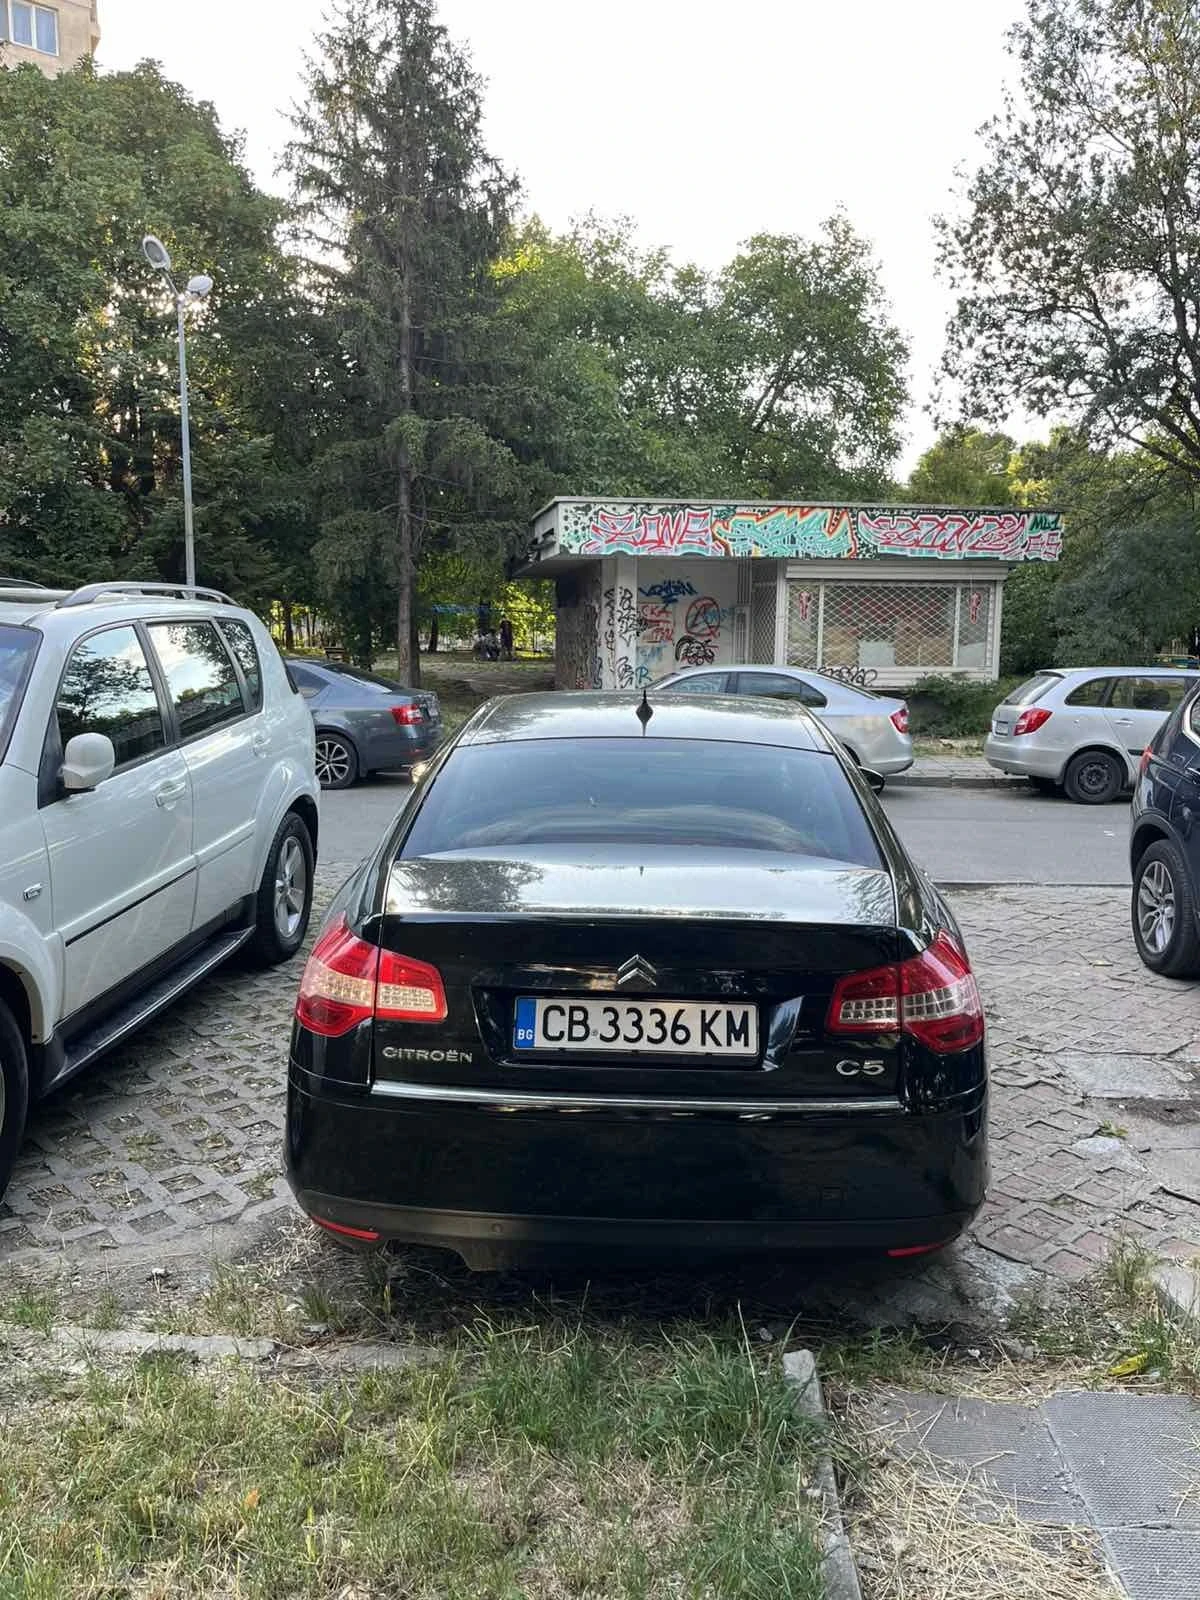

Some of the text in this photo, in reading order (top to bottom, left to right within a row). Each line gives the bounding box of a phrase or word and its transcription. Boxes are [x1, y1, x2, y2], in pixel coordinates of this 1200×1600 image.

[517, 1029, 533, 1040] BG
[542, 1005, 749, 1048] CB 3336 KM
[382, 1046, 473, 1063] CITROËN
[836, 1060, 885, 1075] C5
